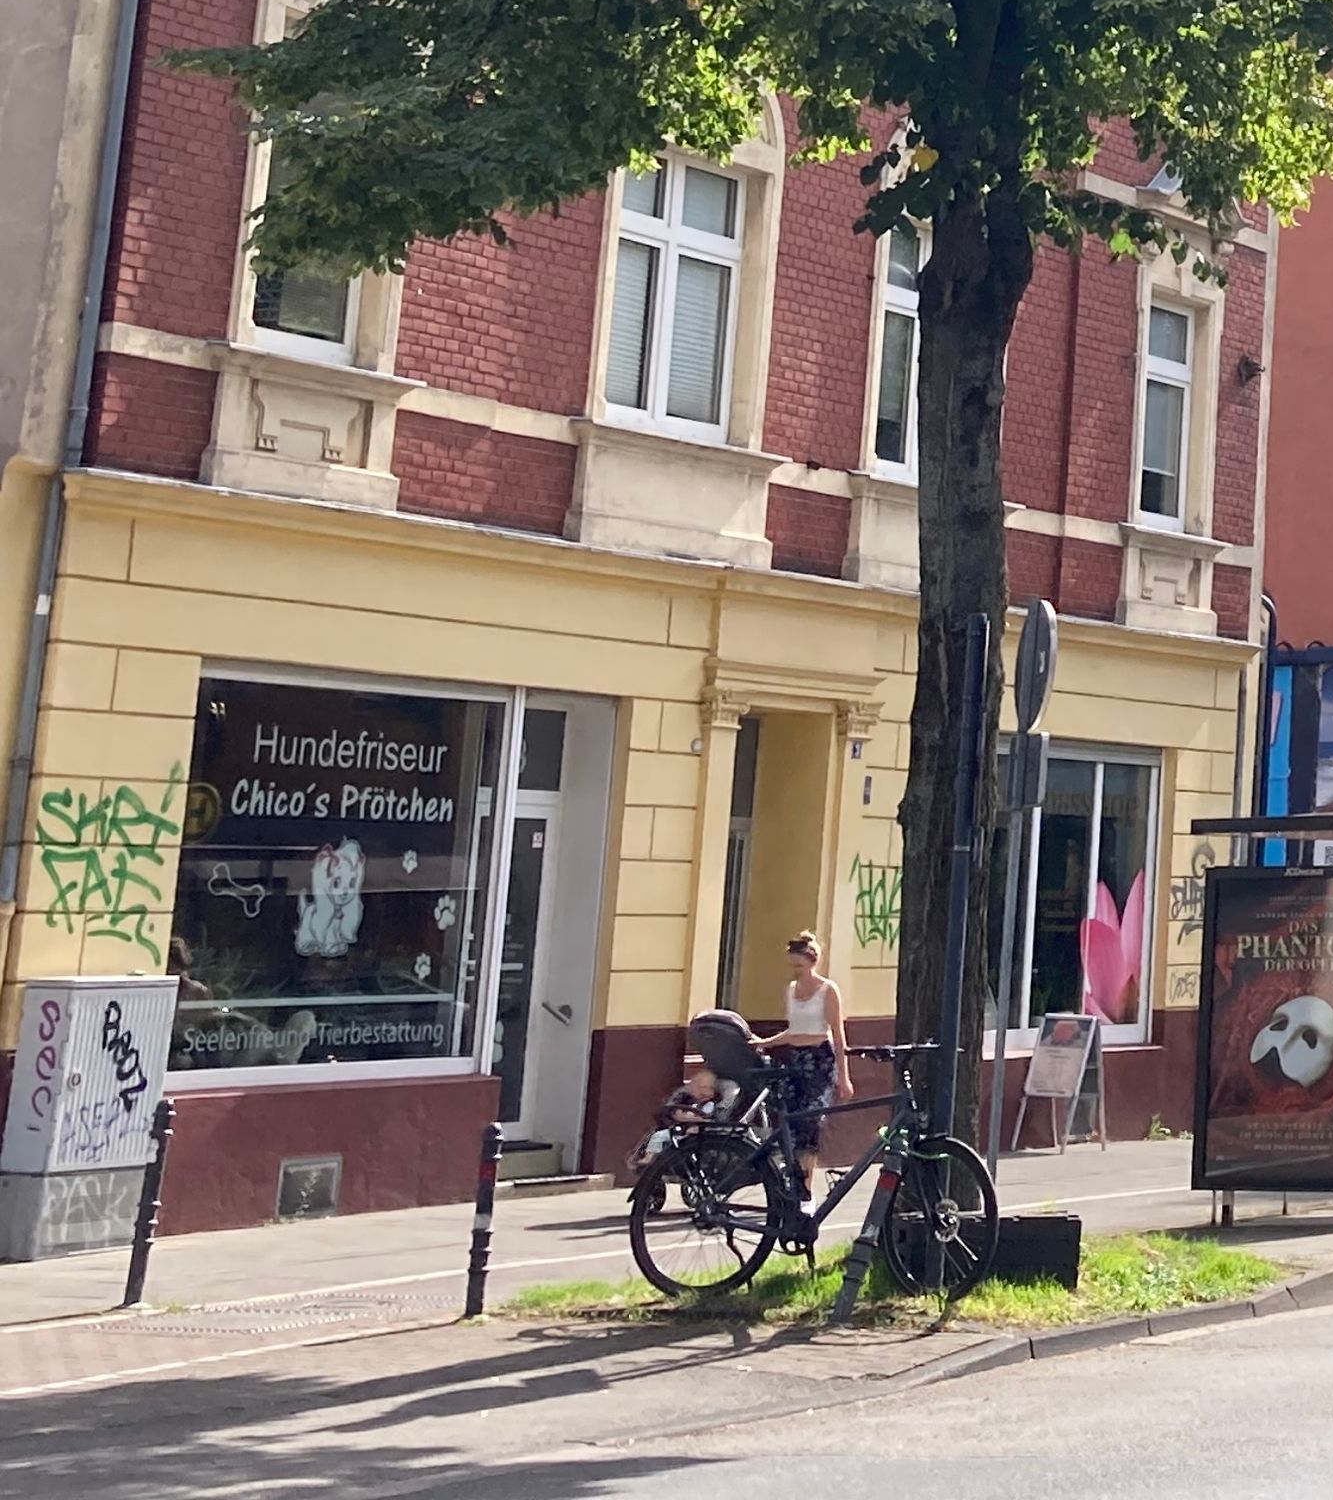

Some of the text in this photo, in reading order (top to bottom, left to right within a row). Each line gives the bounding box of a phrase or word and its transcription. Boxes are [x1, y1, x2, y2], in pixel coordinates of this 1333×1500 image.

[252, 722, 448, 774] Hundefriseur
[340, 783, 454, 823] Pfötchen
[1288, 920, 1319, 934] DAS
[1264, 958, 1296, 972] DER
